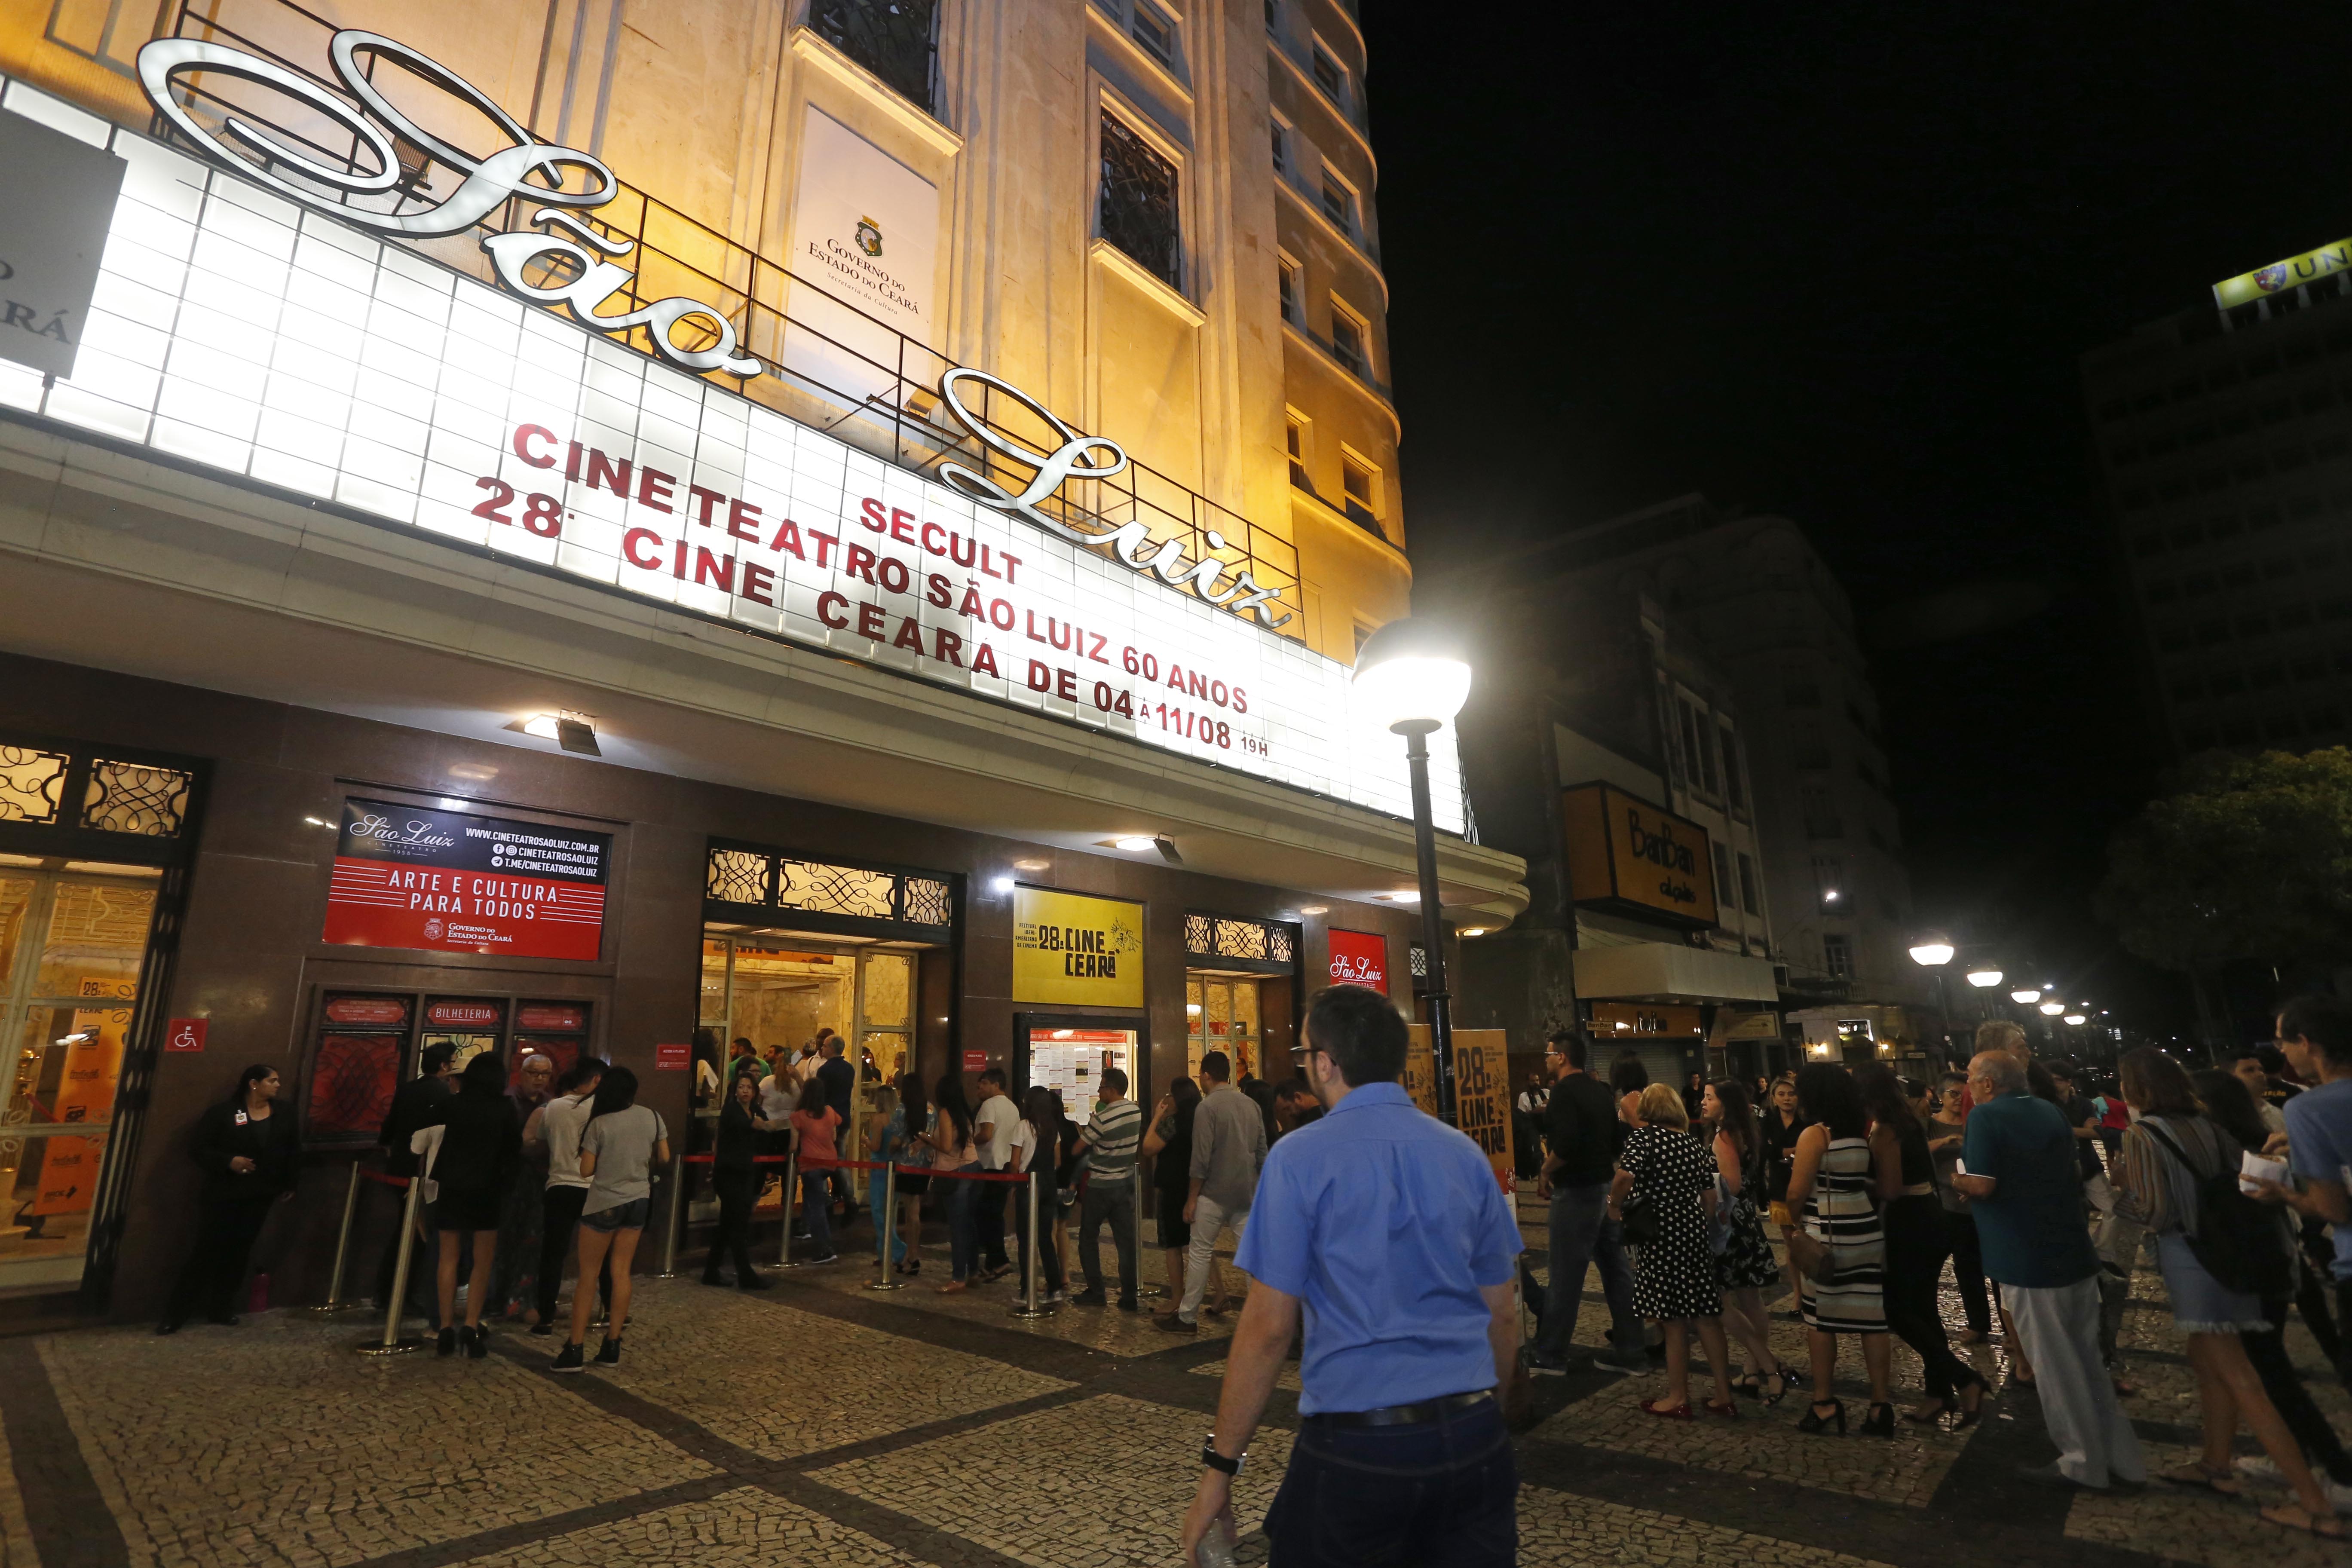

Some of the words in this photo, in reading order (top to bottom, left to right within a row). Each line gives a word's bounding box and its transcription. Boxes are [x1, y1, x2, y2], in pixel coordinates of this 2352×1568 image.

[2294, 243, 2352, 278] UN
[827, 272, 861, 294] Secretaria
[864, 292, 871, 300] da
[874, 298, 898, 315] Cultura
[137, 29, 762, 380] São
[938, 367, 1292, 629] Luiz
[860, 497, 1022, 585] SECULT
[513, 423, 910, 594] CINETEATRO
[927, 573, 1015, 631] SÃO
[1027, 609, 1109, 665] LUIZ
[1123, 646, 1159, 682] 60
[1167, 664, 1247, 714] ANOS
[623, 527, 774, 606] CINE
[1028, 659, 1078, 703] DE
[1094, 681, 1133, 720] 04
[1156, 702, 1231, 749] 11/08
[349, 814, 400, 840] São
[401, 820, 454, 847] Luiz
[466, 827, 599, 853] WWW.CINETEATROSAOLUIZ.COM.BR
[367, 841, 436, 853] CINETEATRO
[518, 847, 598, 865] CINETEATROSAOLUIZ
[505, 858, 597, 877] T.ME/CINETEATROSAOLUIZ
[388, 870, 441, 891] ARTE
[452, 876, 462, 893] E
[473, 879, 557, 903] CULTURA
[410, 892, 462, 914] PARA
[474, 899, 535, 920] TODOS
[1066, 928, 1105, 954] CINE
[1065, 951, 1116, 979] CEARÁ
[1330, 954, 1355, 977] São
[1356, 957, 1382, 981] Luiz
[436, 1008, 490, 1019] BILHETERIA
[1461, 1096, 1495, 1128] CINE
